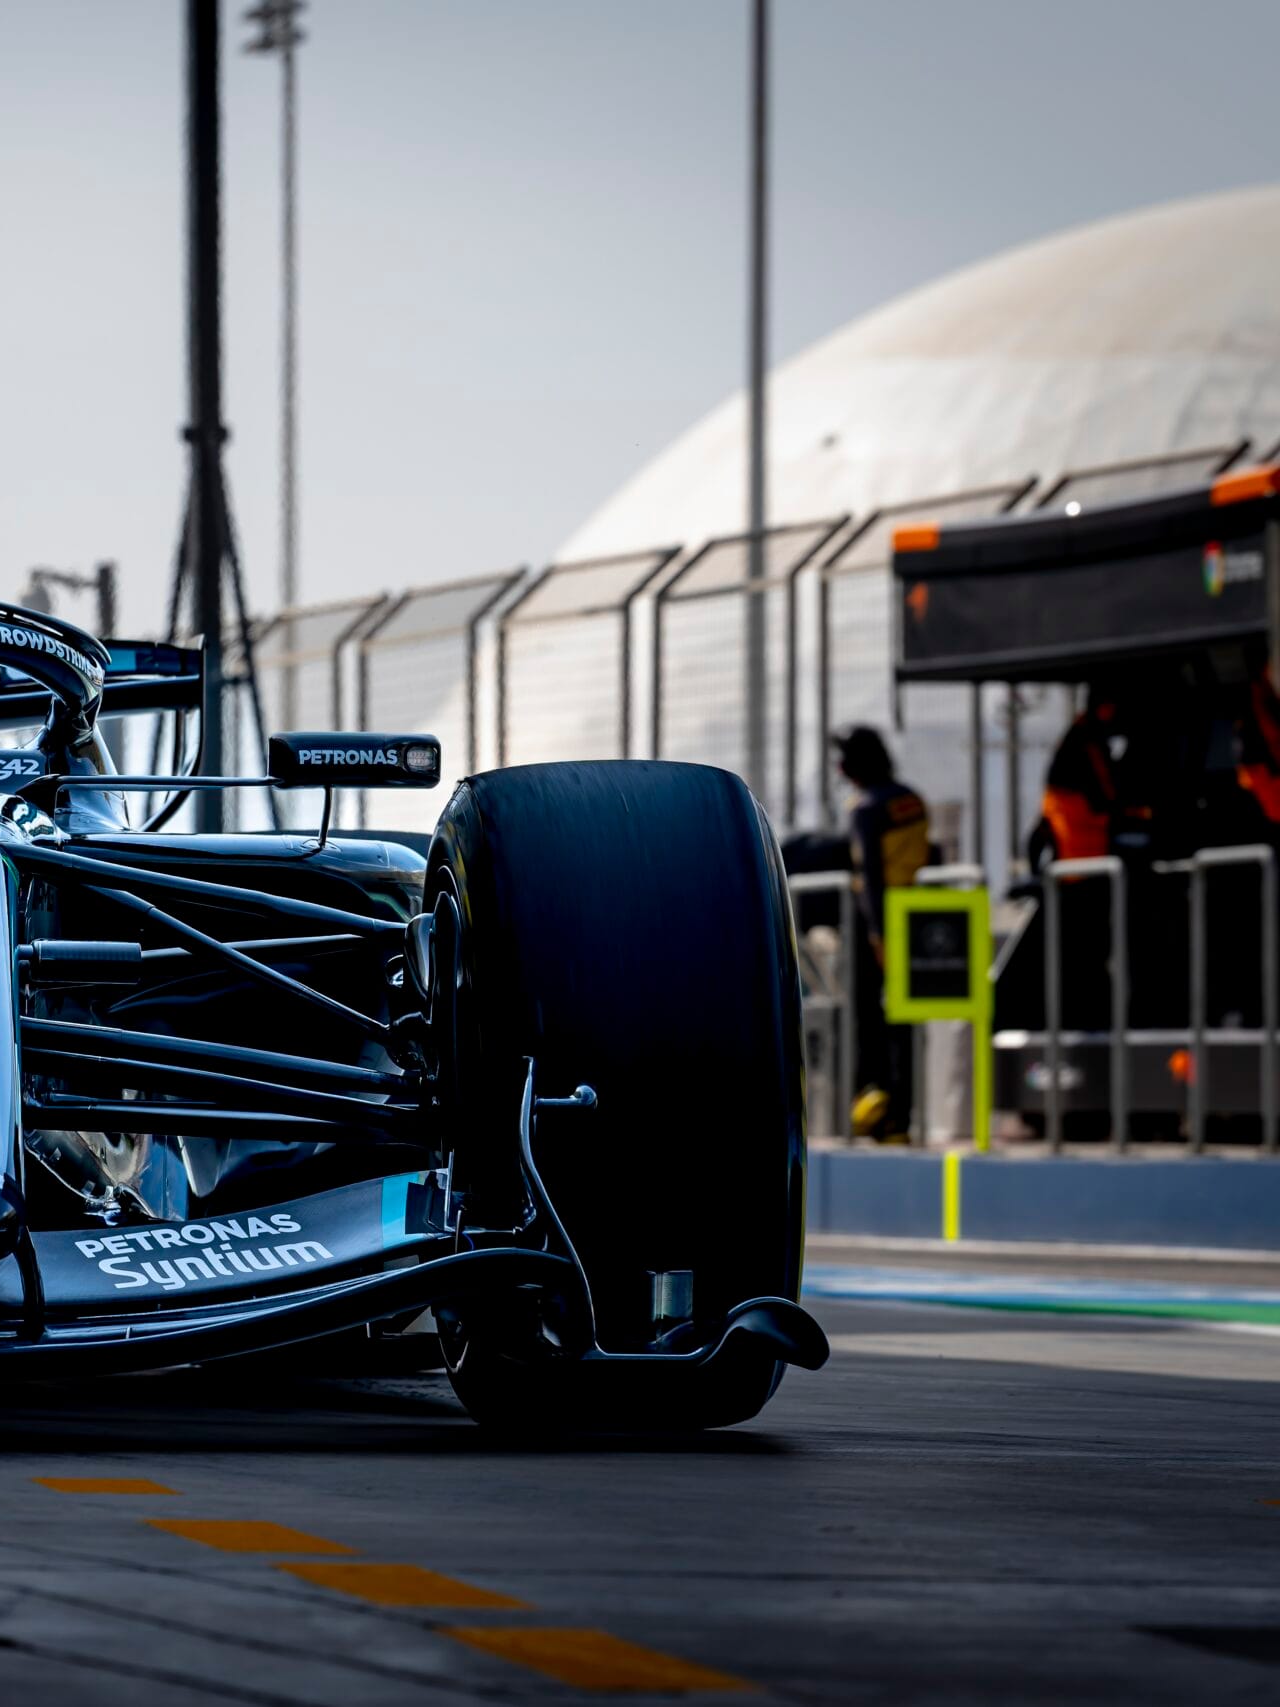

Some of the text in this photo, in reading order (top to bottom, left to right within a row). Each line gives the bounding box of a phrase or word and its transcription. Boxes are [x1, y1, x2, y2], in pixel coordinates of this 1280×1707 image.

[298, 749, 399, 766] PETRONAS
[75, 1214, 303, 1259] PETRONAS
[98, 1240, 334, 1291] Syntium
